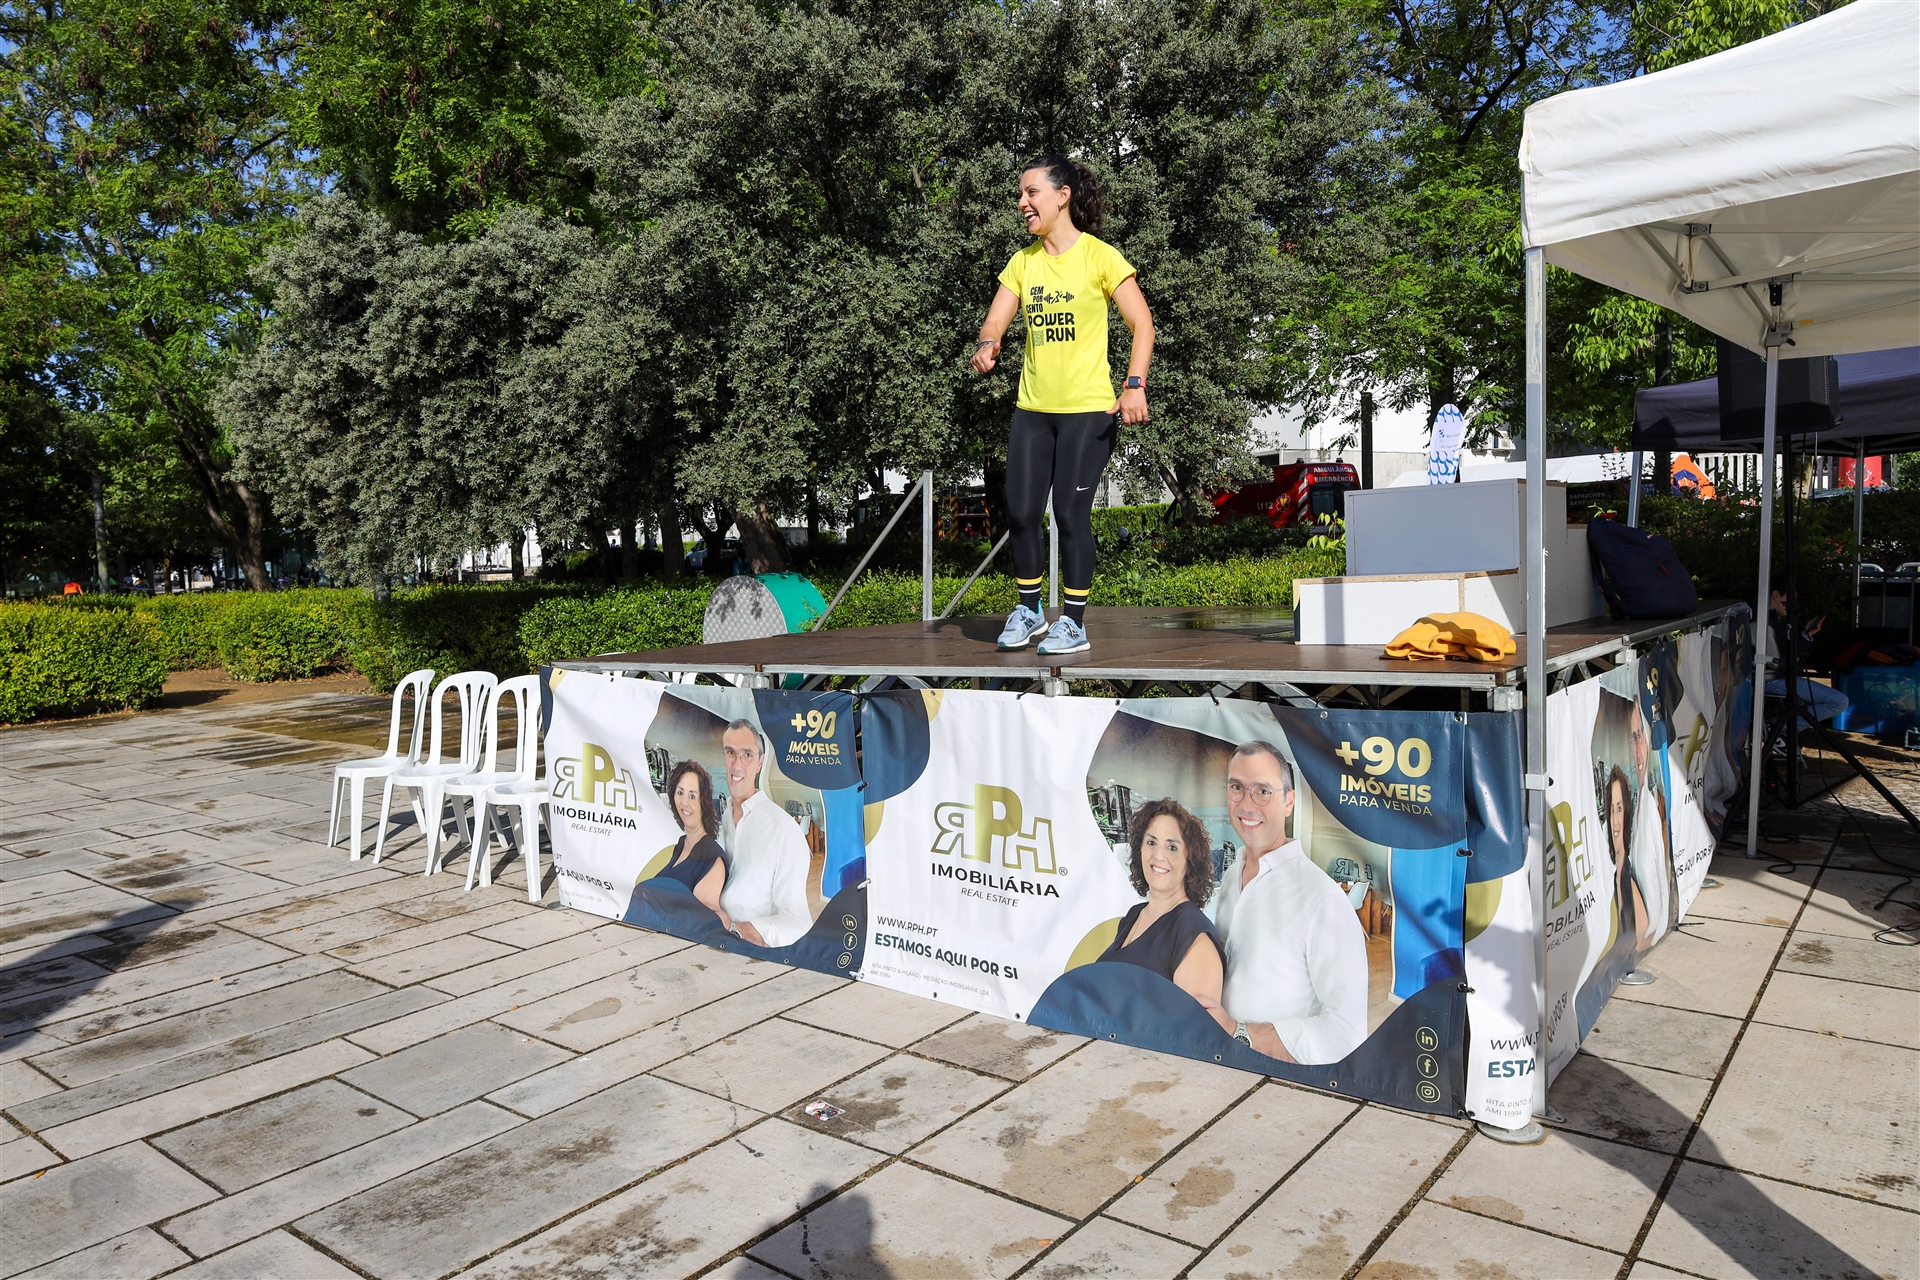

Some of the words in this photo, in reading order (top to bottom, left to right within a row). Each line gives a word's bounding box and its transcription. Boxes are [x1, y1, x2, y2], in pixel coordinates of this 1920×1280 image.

[1030, 286, 1044, 296] CEM
[1033, 295, 1044, 303] POR
[1026, 303, 1044, 314] CENTO
[1028, 312, 1075, 328] POWER
[1046, 327, 1076, 342] RUN
[1314, 475, 1354, 483] EMERGÊNCIA
[790, 709, 837, 739] +90
[788, 739, 840, 756] IMÓVEIS
[785, 754, 807, 765] PARA
[807, 757, 842, 765] VENDA
[1334, 736, 1432, 778] +90
[1340, 774, 1432, 803] IMÓVEIS
[1339, 794, 1379, 808] PARA
[1382, 798, 1433, 816] VENDA
[553, 805, 637, 830] IMOBILIÁRIA
[571, 822, 588, 831] REAL
[589, 826, 612, 836] ESTATE
[585, 875, 604, 888] POR
[603, 881, 615, 891] SI
[931, 863, 1060, 898] IMOBILIÁRIA
[961, 887, 984, 900] REAL
[986, 893, 1020, 907] ESTATE
[1546, 891, 1596, 938] OBILIÁRIA
[877, 915, 938, 938] WWW.RPH.PT
[875, 932, 932, 958] ESTAMOS
[935, 949, 967, 967] AQUI
[970, 957, 1000, 977] POR
[1003, 965, 1019, 980] SI
[1488, 1057, 1536, 1078] ESTA
[1485, 1106, 1502, 1116] AMI
[1486, 1098, 1505, 1108] RITA
[1507, 1098, 1528, 1108] PINTO
